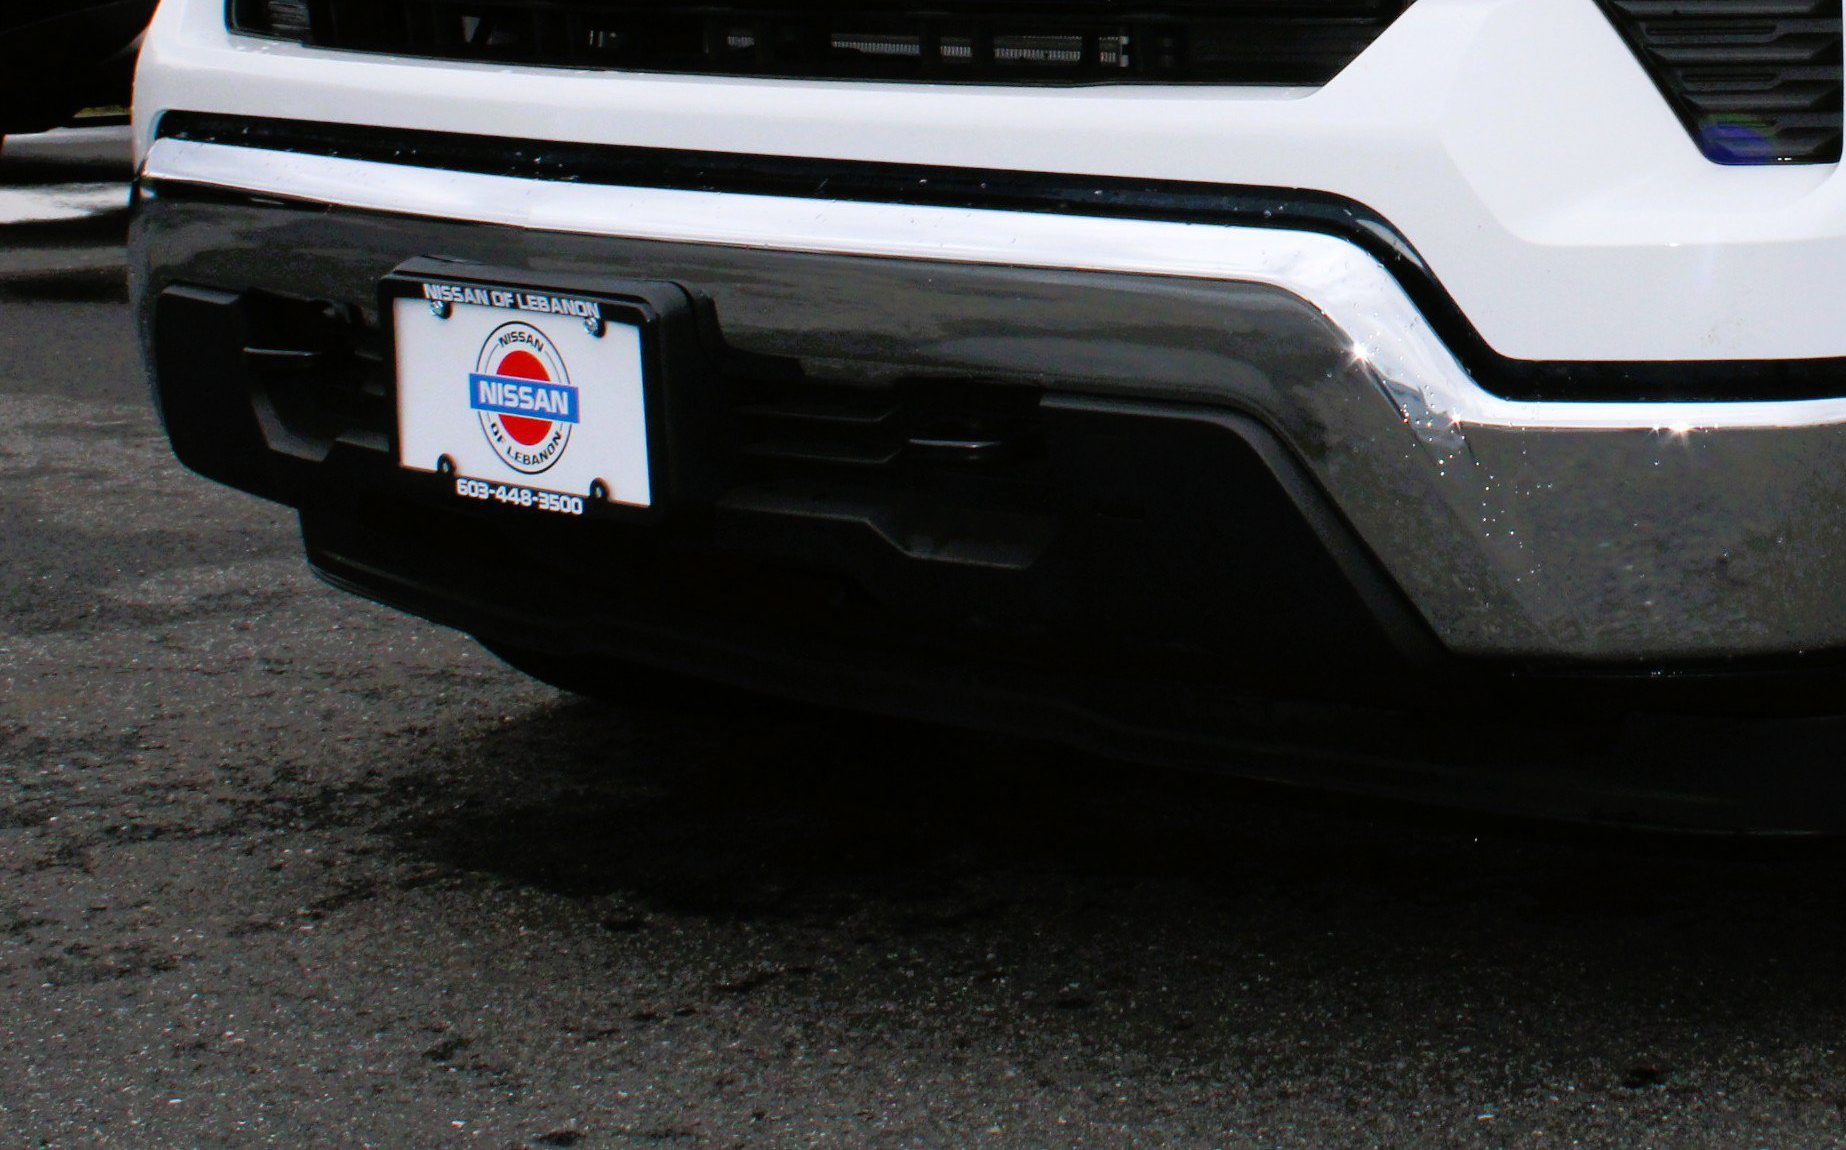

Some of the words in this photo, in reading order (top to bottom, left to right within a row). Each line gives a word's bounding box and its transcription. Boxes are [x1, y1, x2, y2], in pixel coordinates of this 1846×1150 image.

[423, 283, 490, 306] NISSAN
[490, 290, 515, 308] OF
[515, 292, 601, 319] LEBANON
[499, 330, 544, 352] NISSAN
[478, 379, 569, 416] NISSAN
[490, 421, 506, 443] OF
[506, 430, 562, 466] LEBANON
[456, 477, 583, 515] 603-448-3500
